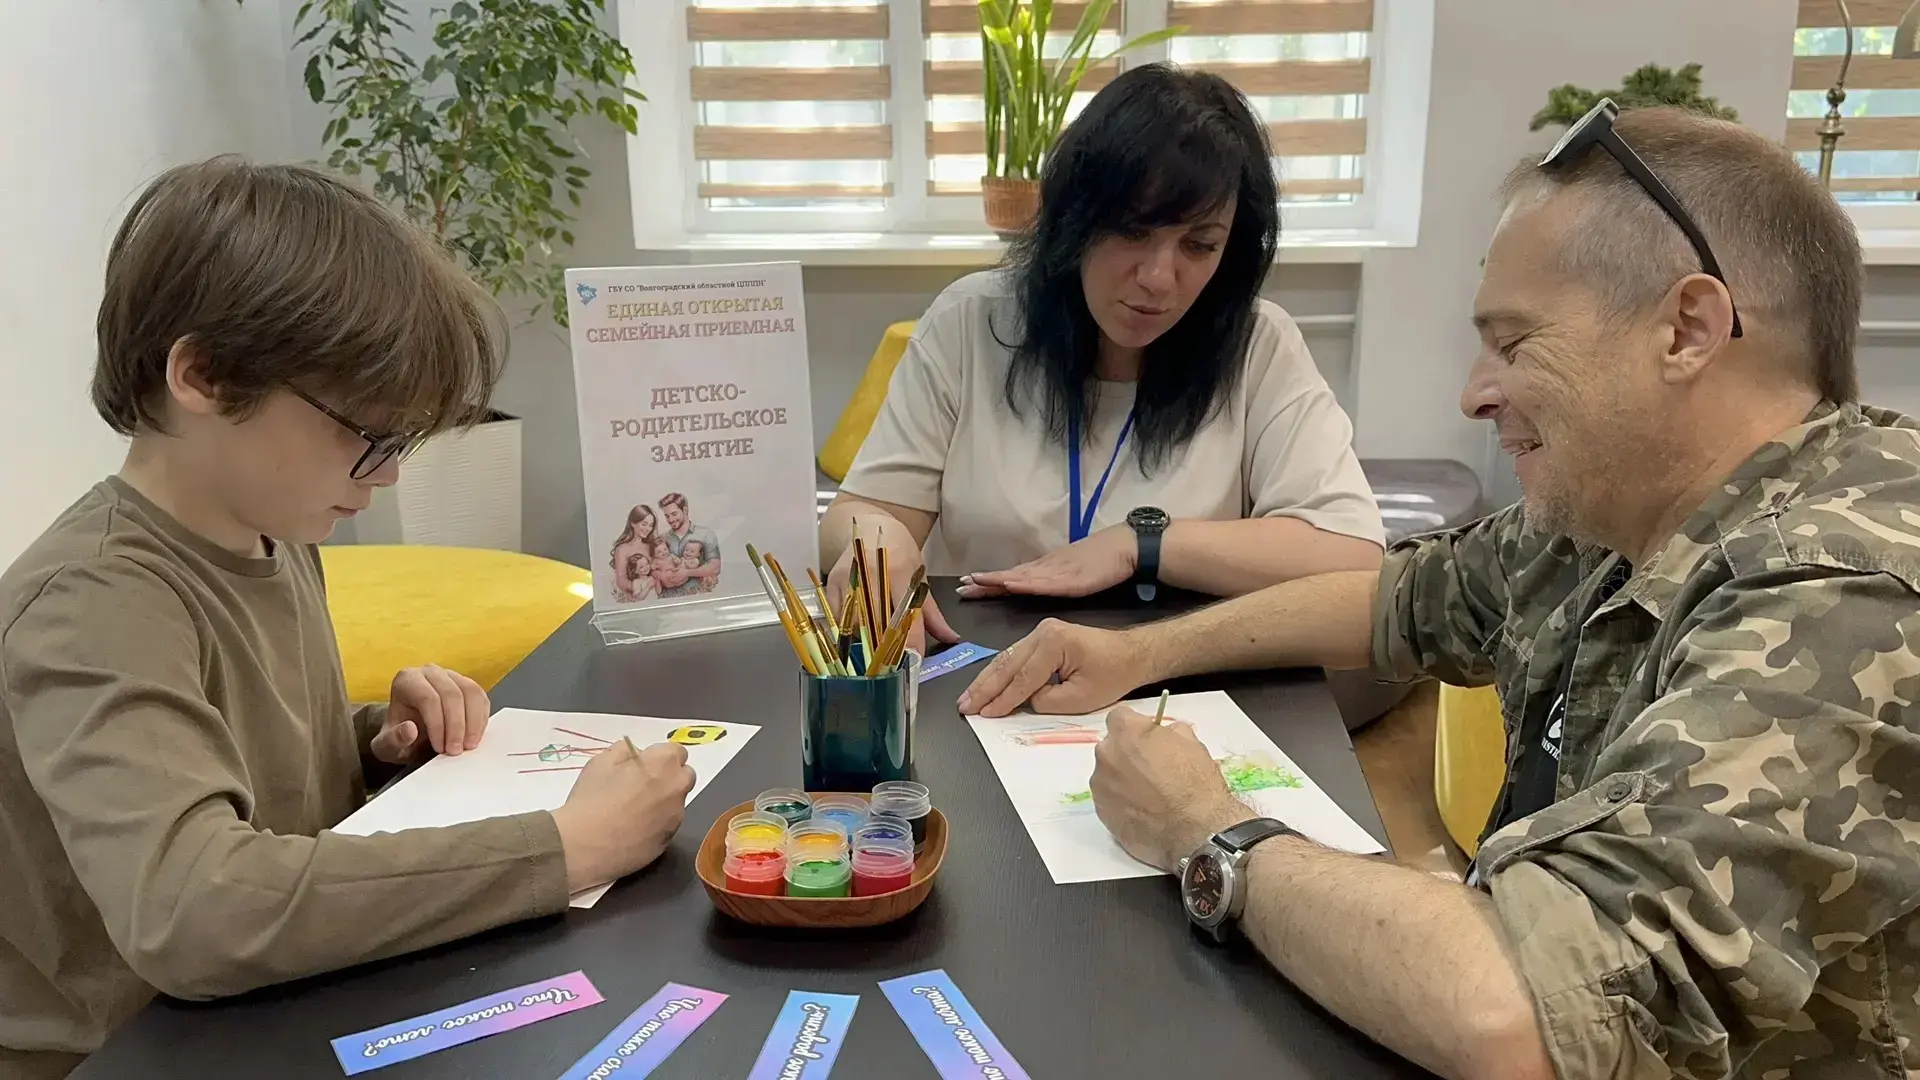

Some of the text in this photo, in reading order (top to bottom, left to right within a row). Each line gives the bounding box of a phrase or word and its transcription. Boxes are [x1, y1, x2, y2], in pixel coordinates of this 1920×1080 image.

[608, 285, 622, 293] ГБУ
[637, 282, 696, 293] "Волгоградский
[697, 281, 735, 290] областной
[606, 297, 784, 321] ЕДИНАЯ ОТКРЫТАЯ
[586, 318, 795, 343] СЕМЕЙНАЯ ПРИЕМНАЯ
[650, 383, 747, 409] ДЕТСКО-
[610, 407, 788, 439] РОДИТЕЛЬСКОЕ
[650, 438, 755, 463] ЗАНЯТИЕ
[656, 998, 703, 1020] Что
[911, 986, 964, 1026] мечта?
[363, 988, 579, 1057] Что такое лето?
[791, 1002, 830, 1059] радость?
[616, 1019, 664, 1057] такое
[953, 1028, 994, 1065] такое
